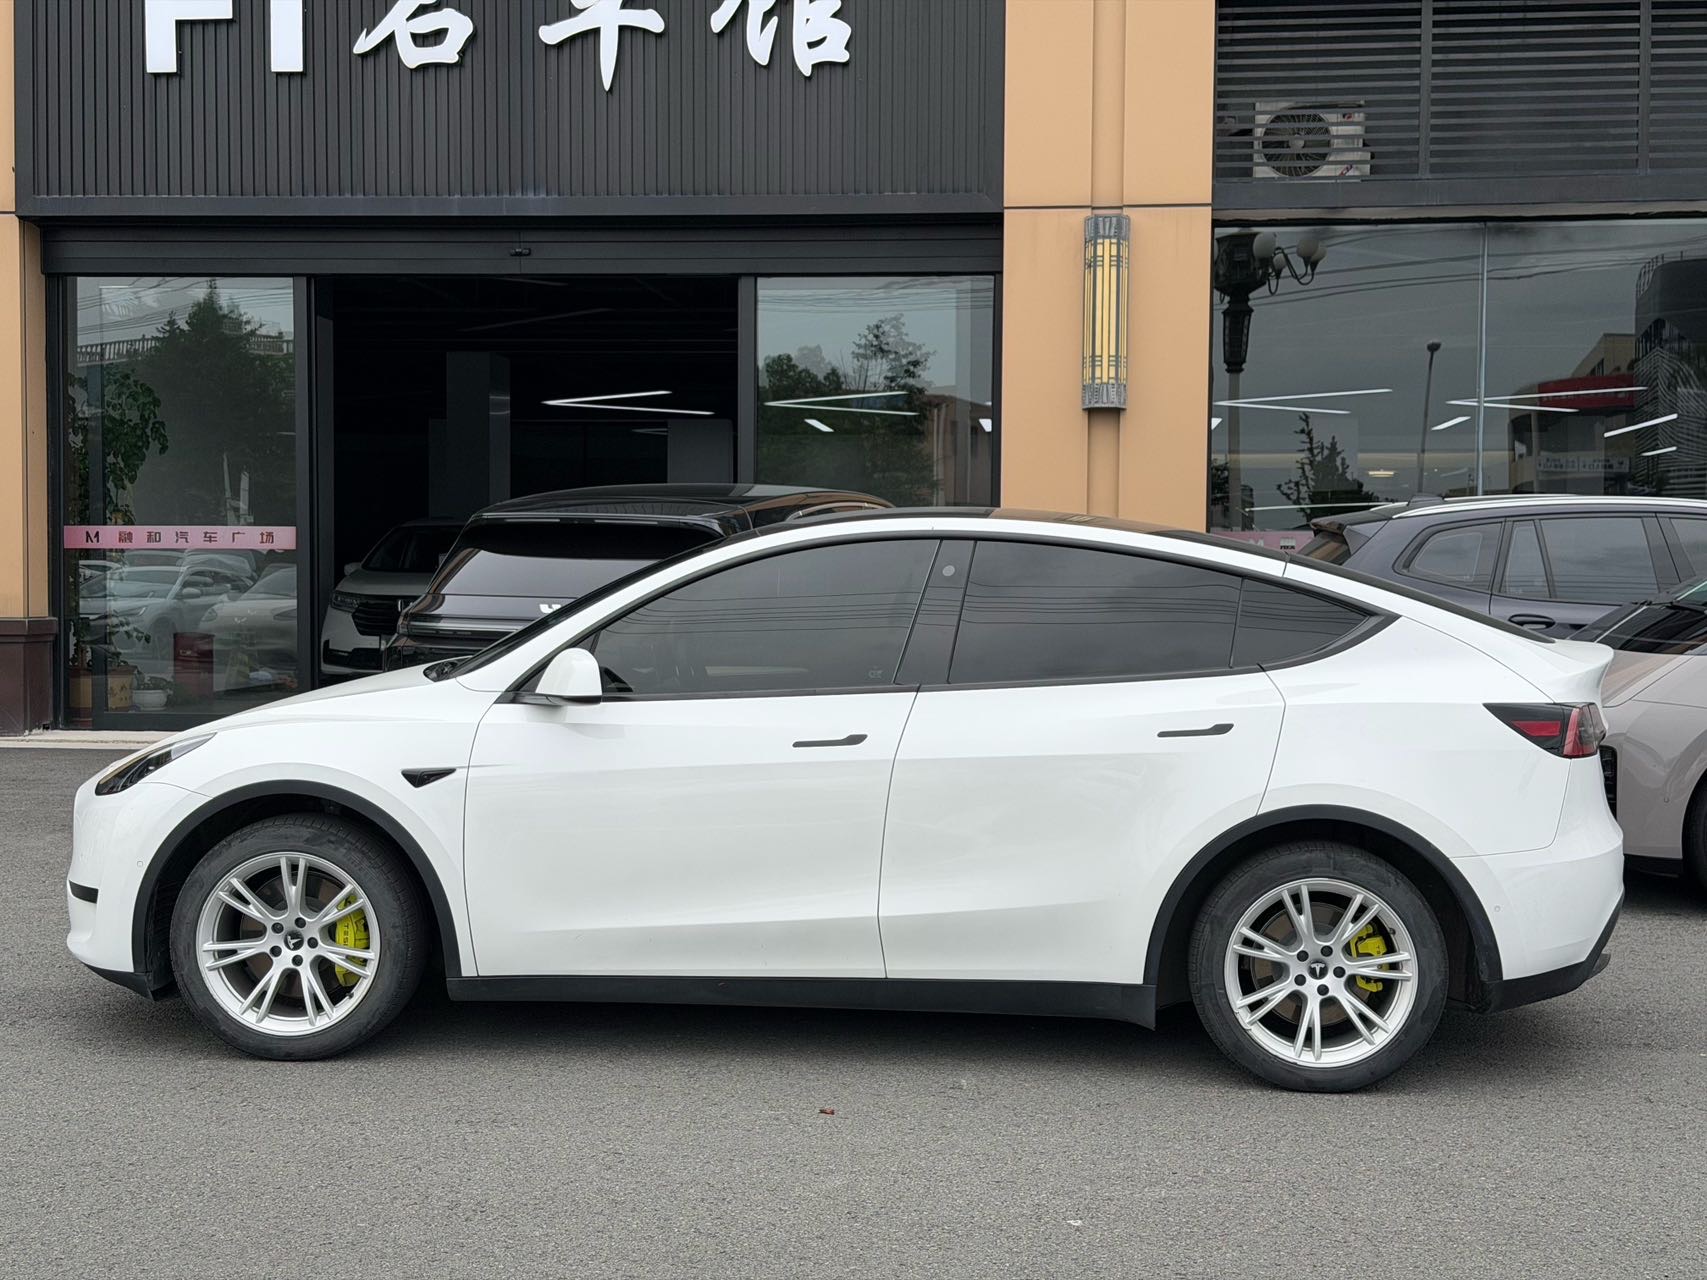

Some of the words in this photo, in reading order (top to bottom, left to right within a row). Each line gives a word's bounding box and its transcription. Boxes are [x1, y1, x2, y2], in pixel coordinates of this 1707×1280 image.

[118, 530, 275, 545] 融和汽车广场
